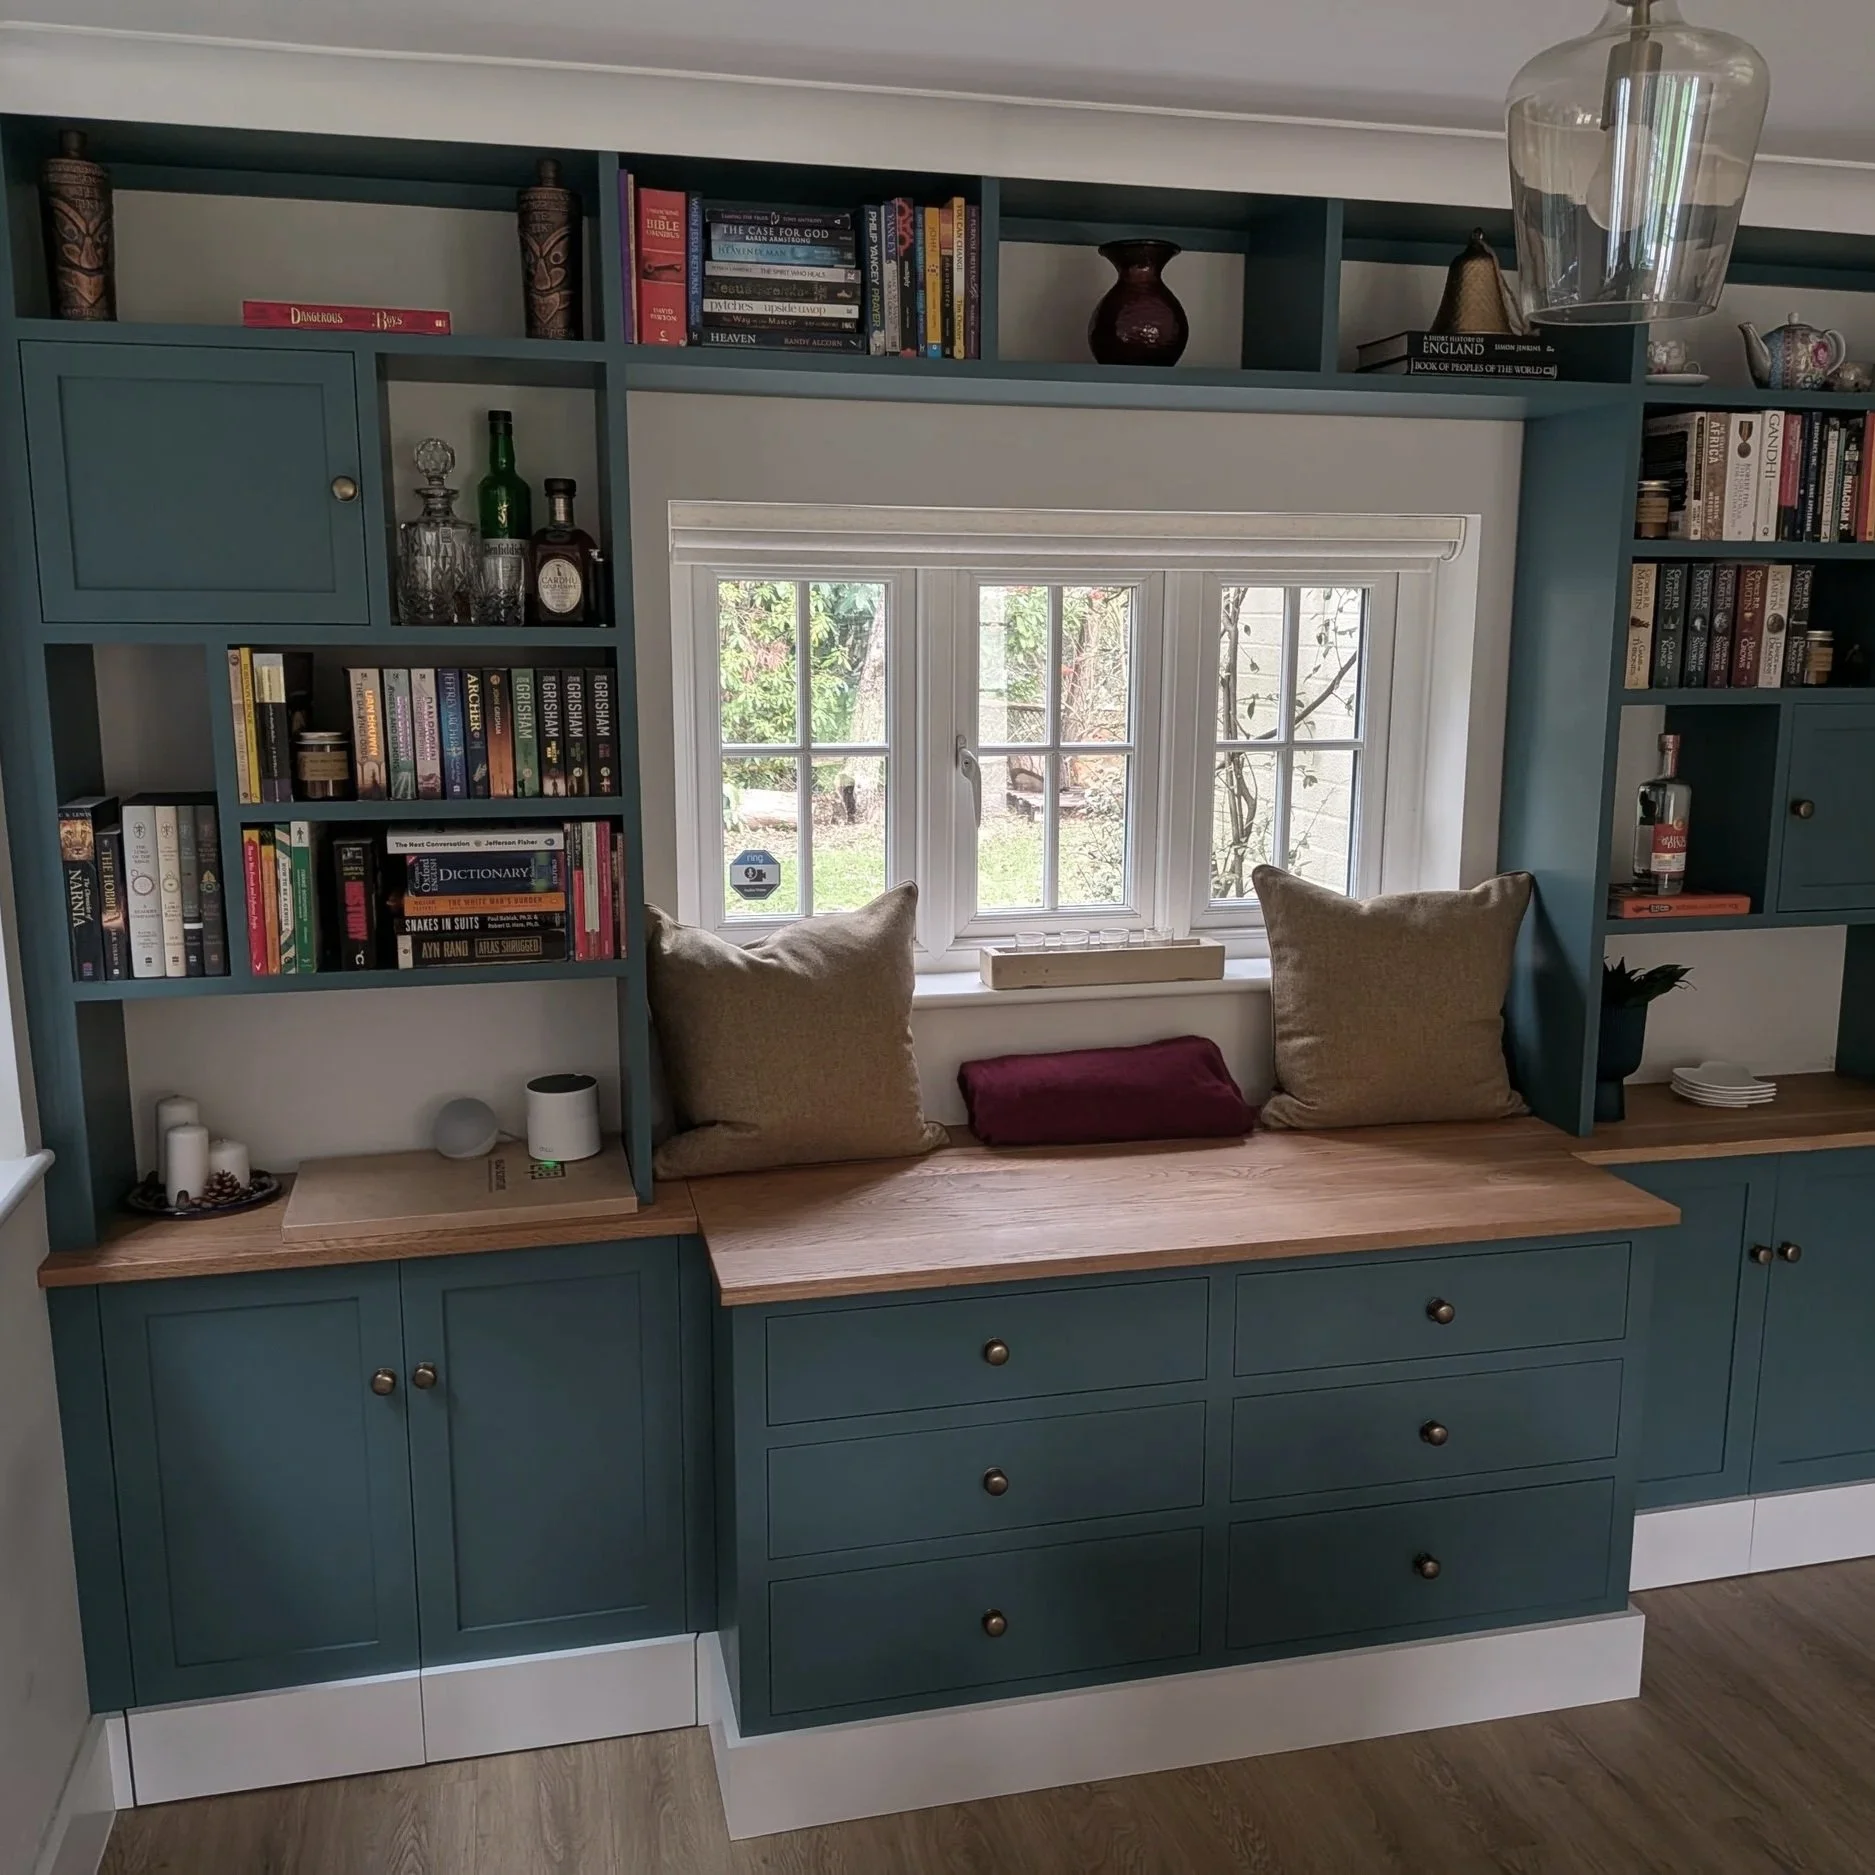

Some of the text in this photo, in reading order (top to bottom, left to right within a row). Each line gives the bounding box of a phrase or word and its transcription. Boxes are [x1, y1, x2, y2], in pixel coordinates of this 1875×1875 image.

[646, 218, 681, 232] BIBLE
[646, 230, 681, 239] OMNIBUS
[723, 224, 829, 239] THE CASE FOR GOD
[745, 234, 811, 244] KAREN ARMSTRONG
[887, 215, 896, 254] YANCEY
[928, 227, 937, 252] JOHN
[690, 197, 699, 295] WHEN JESUS RETURNS
[807, 270, 825, 278] HEALS
[869, 210, 881, 328] PHILIP YANCEY PRAYER
[649, 313, 678, 322] PAWSON
[652, 306, 675, 315] DAVID
[710, 300, 754, 314] pytches
[732, 315, 797, 326] Way Master
[764, 304, 797, 315] upside
[710, 332, 756, 344] HEAVEN
[784, 337, 842, 347] RANDY ALCORN
[1423, 342, 1485, 355] ENGLAND
[1494, 343, 1515, 351] SIMON
[1415, 362, 1543, 375] BOOK OF PEOPLES OF THE WORLD
[1708, 421, 1720, 464] AFRICA
[1765, 413, 1780, 479] GANDHI
[1825, 463, 1834, 514] CRUSADES
[1841, 474, 1853, 521] MALCOLM
[1706, 491, 1714, 523] MEREDITH
[1805, 483, 1816, 532] ANNE APPLEBAUM
[1839, 522, 1849, 531] X
[541, 575, 578, 585] CARDHU
[1635, 569, 1646, 610] MARTIN
[1664, 569, 1675, 610] MARTIN
[1694, 569, 1704, 610] MARTIN
[1718, 569, 1728, 610] MARTIN
[1743, 570, 1755, 611] MARTIN
[1769, 571, 1779, 611] MARTIN
[1793, 570, 1804, 611] MARTIN
[1629, 637, 1640, 676] THRONES
[1638, 644, 1646, 665] GAME
[1660, 640, 1669, 666] KINGS
[1668, 641, 1676, 663] CLASH
[1690, 637, 1700, 672] SWORDS
[1698, 641, 1707, 664] STORM
[1712, 636, 1722, 671] SWORDS
[1721, 641, 1729, 664] STORM
[1739, 638, 1749, 669] CROWS
[1768, 637, 1776, 674] DRAGONS
[1789, 636, 1798, 674] DRAGONS
[388, 684, 396, 716] ANGELS
[442, 673, 457, 709] JEFFREY
[466, 673, 482, 732] ARCHER
[492, 687, 503, 735] JOHN GRISHAM
[516, 683, 533, 739] GRISHAM
[542, 682, 560, 738] GRISHAM
[567, 683, 584, 738] GRISHAM
[594, 682, 611, 737] GRISHAM
[367, 714, 379, 756] BROWN
[423, 697, 437, 761] DAN BROWN
[447, 711, 460, 747] ARCHER
[361, 740, 369, 762] CODE
[391, 737, 400, 770] DEMONS
[426, 840, 470, 848] Conversation
[746, 855, 764, 864] ring
[101, 849, 118, 916] THE HOBBIT
[420, 857, 430, 893] Oxford
[430, 858, 438, 892] ENGLISH
[439, 867, 529, 881] DICTIONARY
[68, 868, 87, 929] NARNIA
[405, 916, 479, 932] SNAKES IN SUITS
[421, 940, 468, 958] AYN RAND
[478, 939, 539, 954] ATLAS SHRUGGED
